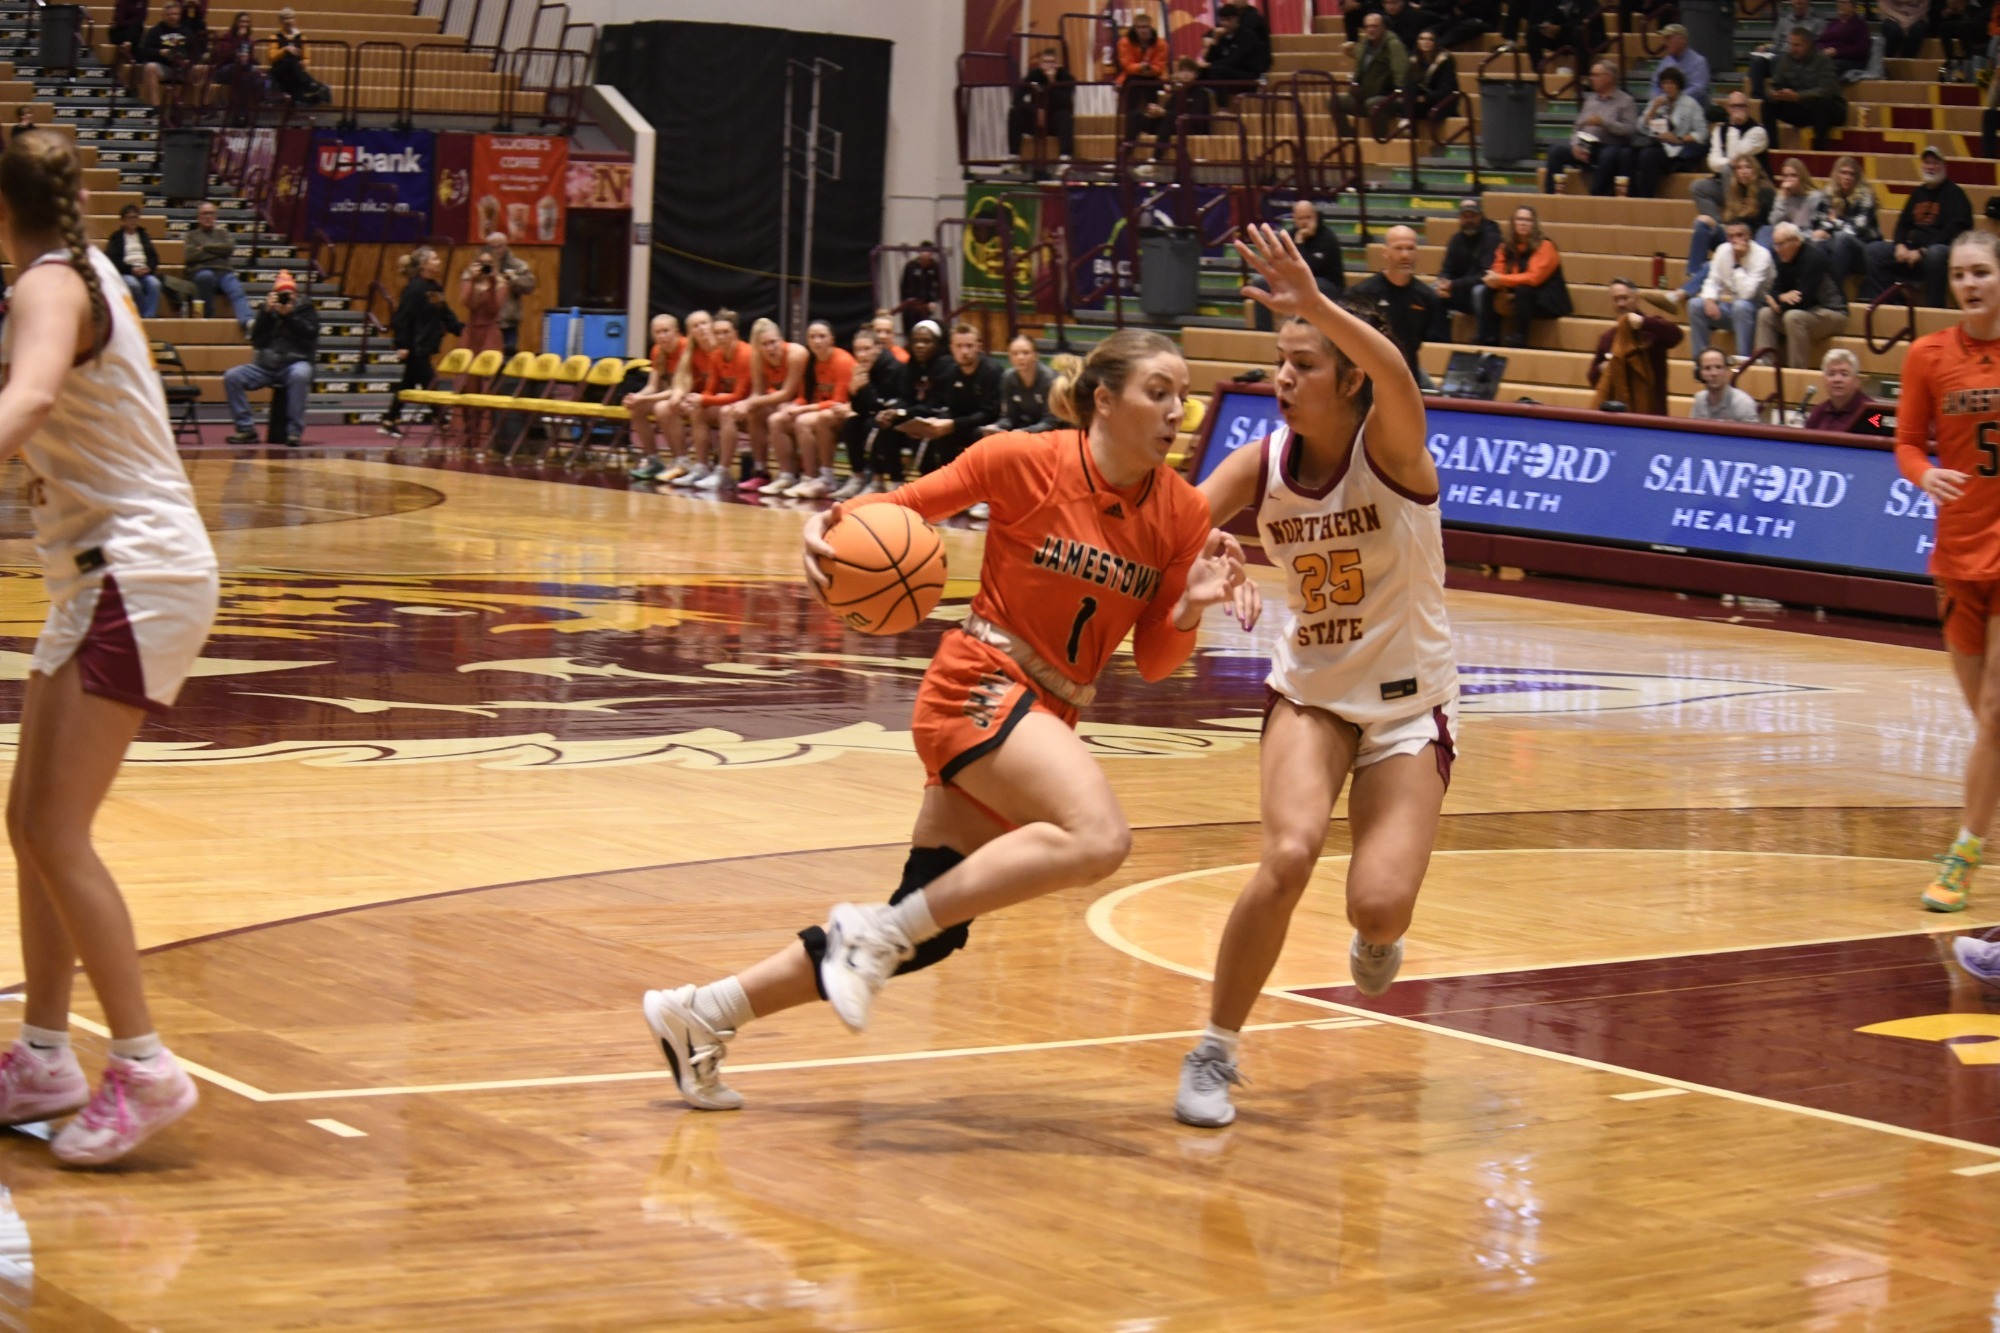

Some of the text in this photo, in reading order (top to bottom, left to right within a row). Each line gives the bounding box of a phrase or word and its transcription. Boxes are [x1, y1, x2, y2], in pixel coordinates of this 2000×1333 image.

[356, 145, 422, 172] bank
[1447, 484, 1562, 513] HEALTH
[1643, 454, 1847, 508] SANFORD
[1266, 504, 1381, 544] NORTHERN
[1671, 508, 1796, 539] HEALTH
[1292, 549, 1365, 614] 25
[1067, 596, 1097, 664] 1
[1298, 618, 1363, 646] STATE
